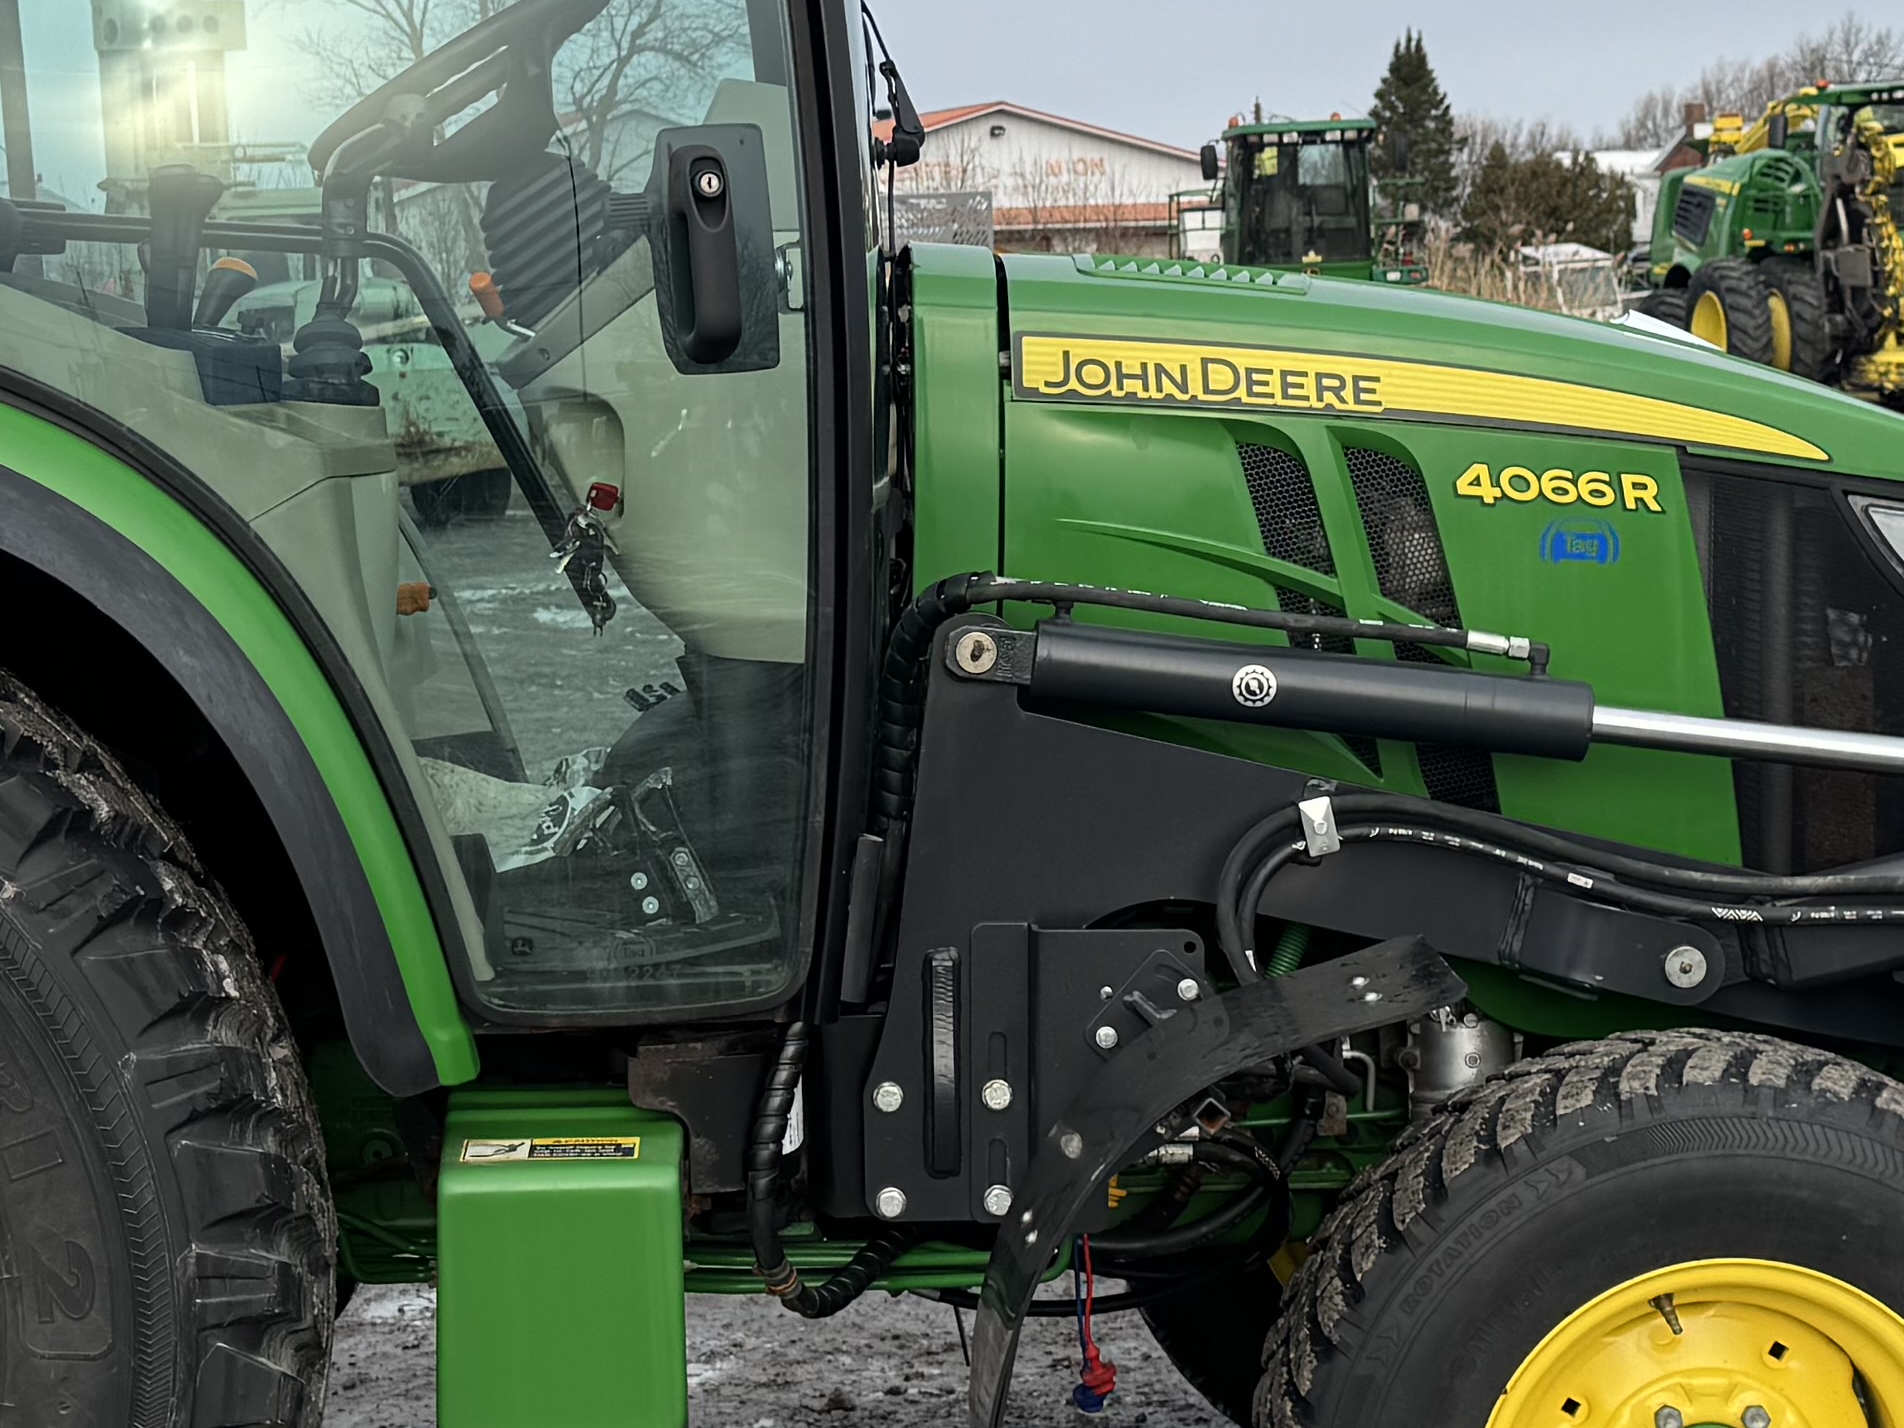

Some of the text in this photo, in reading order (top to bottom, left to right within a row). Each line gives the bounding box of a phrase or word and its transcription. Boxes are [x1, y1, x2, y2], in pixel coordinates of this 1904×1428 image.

[1043, 349, 1383, 407] JOHN DEERE
[1565, 533, 1599, 557] Tag
[1397, 1189, 1524, 1318] ROTATION
